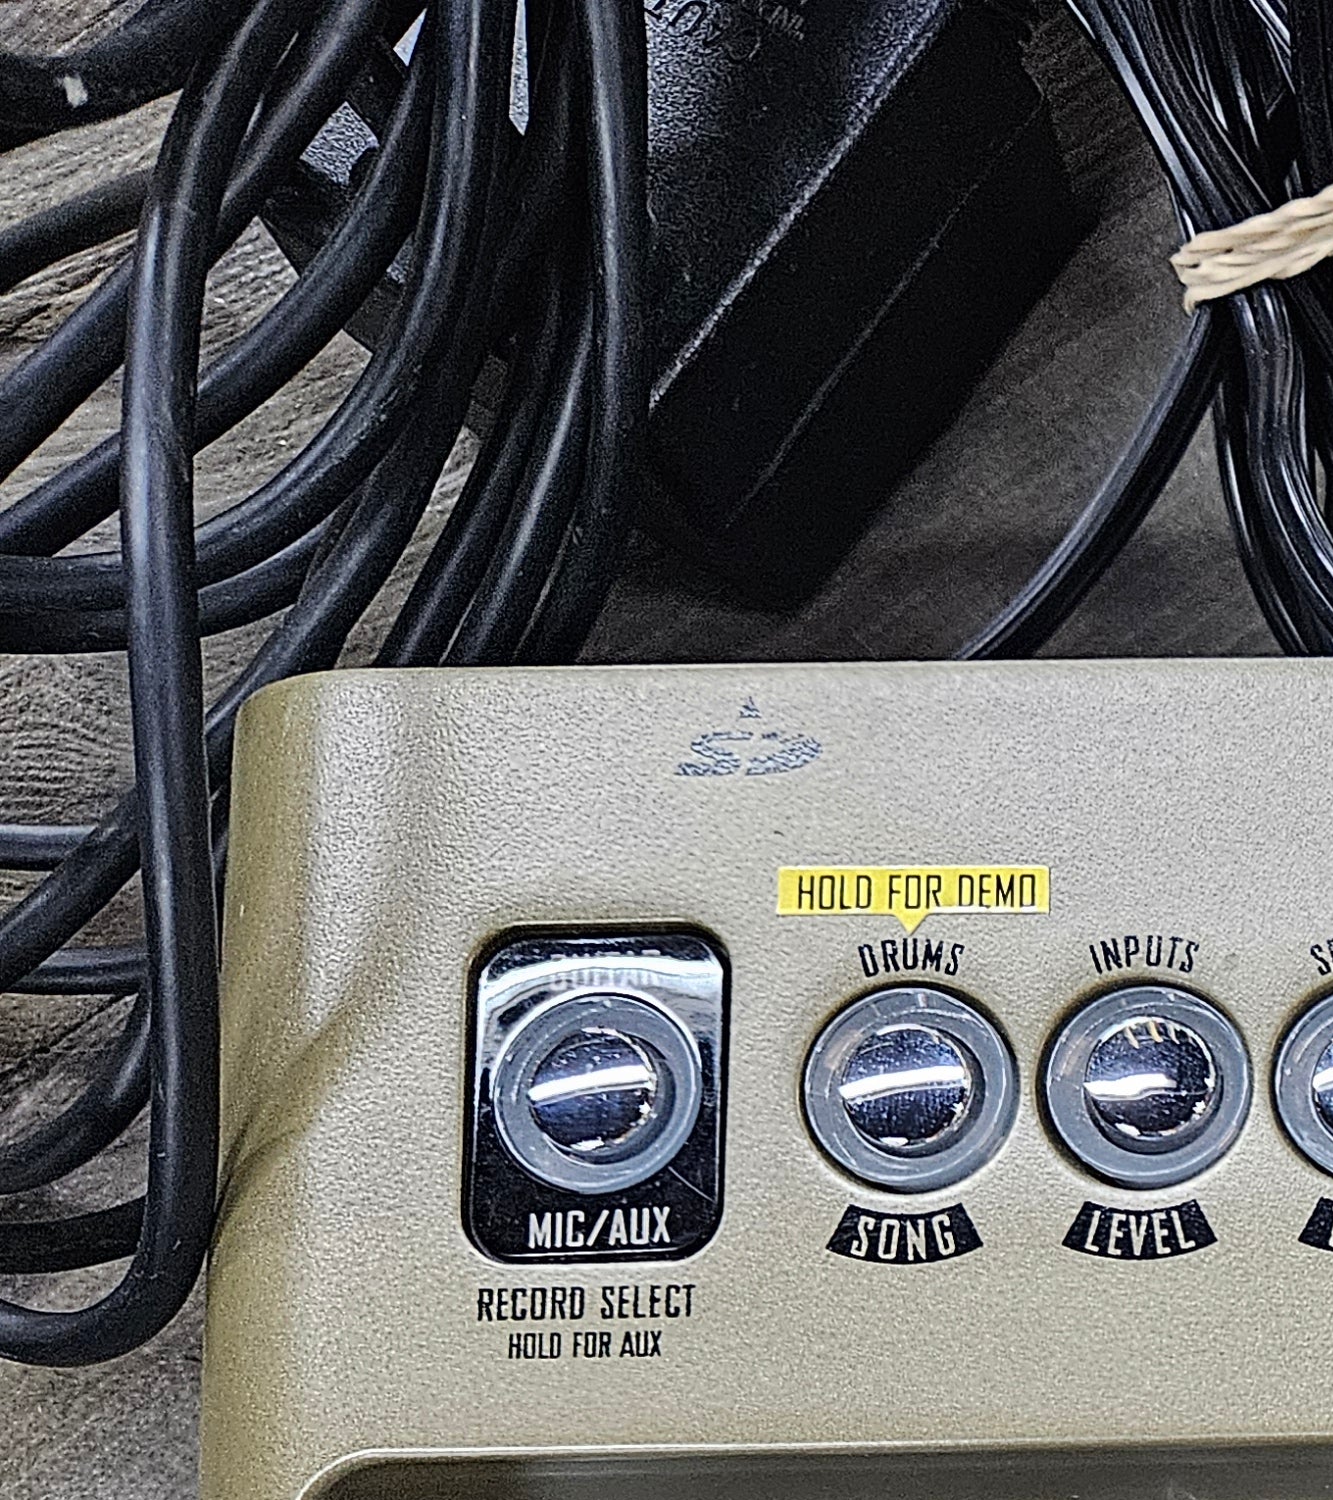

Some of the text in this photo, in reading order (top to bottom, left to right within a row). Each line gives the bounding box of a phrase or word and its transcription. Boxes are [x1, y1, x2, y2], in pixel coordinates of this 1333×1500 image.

[798, 873, 1036, 910] HOLD FOR DEMO
[858, 938, 965, 978] DRUMS
[1089, 935, 1200, 974] INPUTS
[528, 1206, 671, 1249] MIC/AUX
[852, 1215, 954, 1261] SONG
[1084, 1211, 1196, 1254] LEVEL
[477, 1284, 696, 1321] RECORD SELECT
[508, 1330, 662, 1359] HOLD FOR AUX
